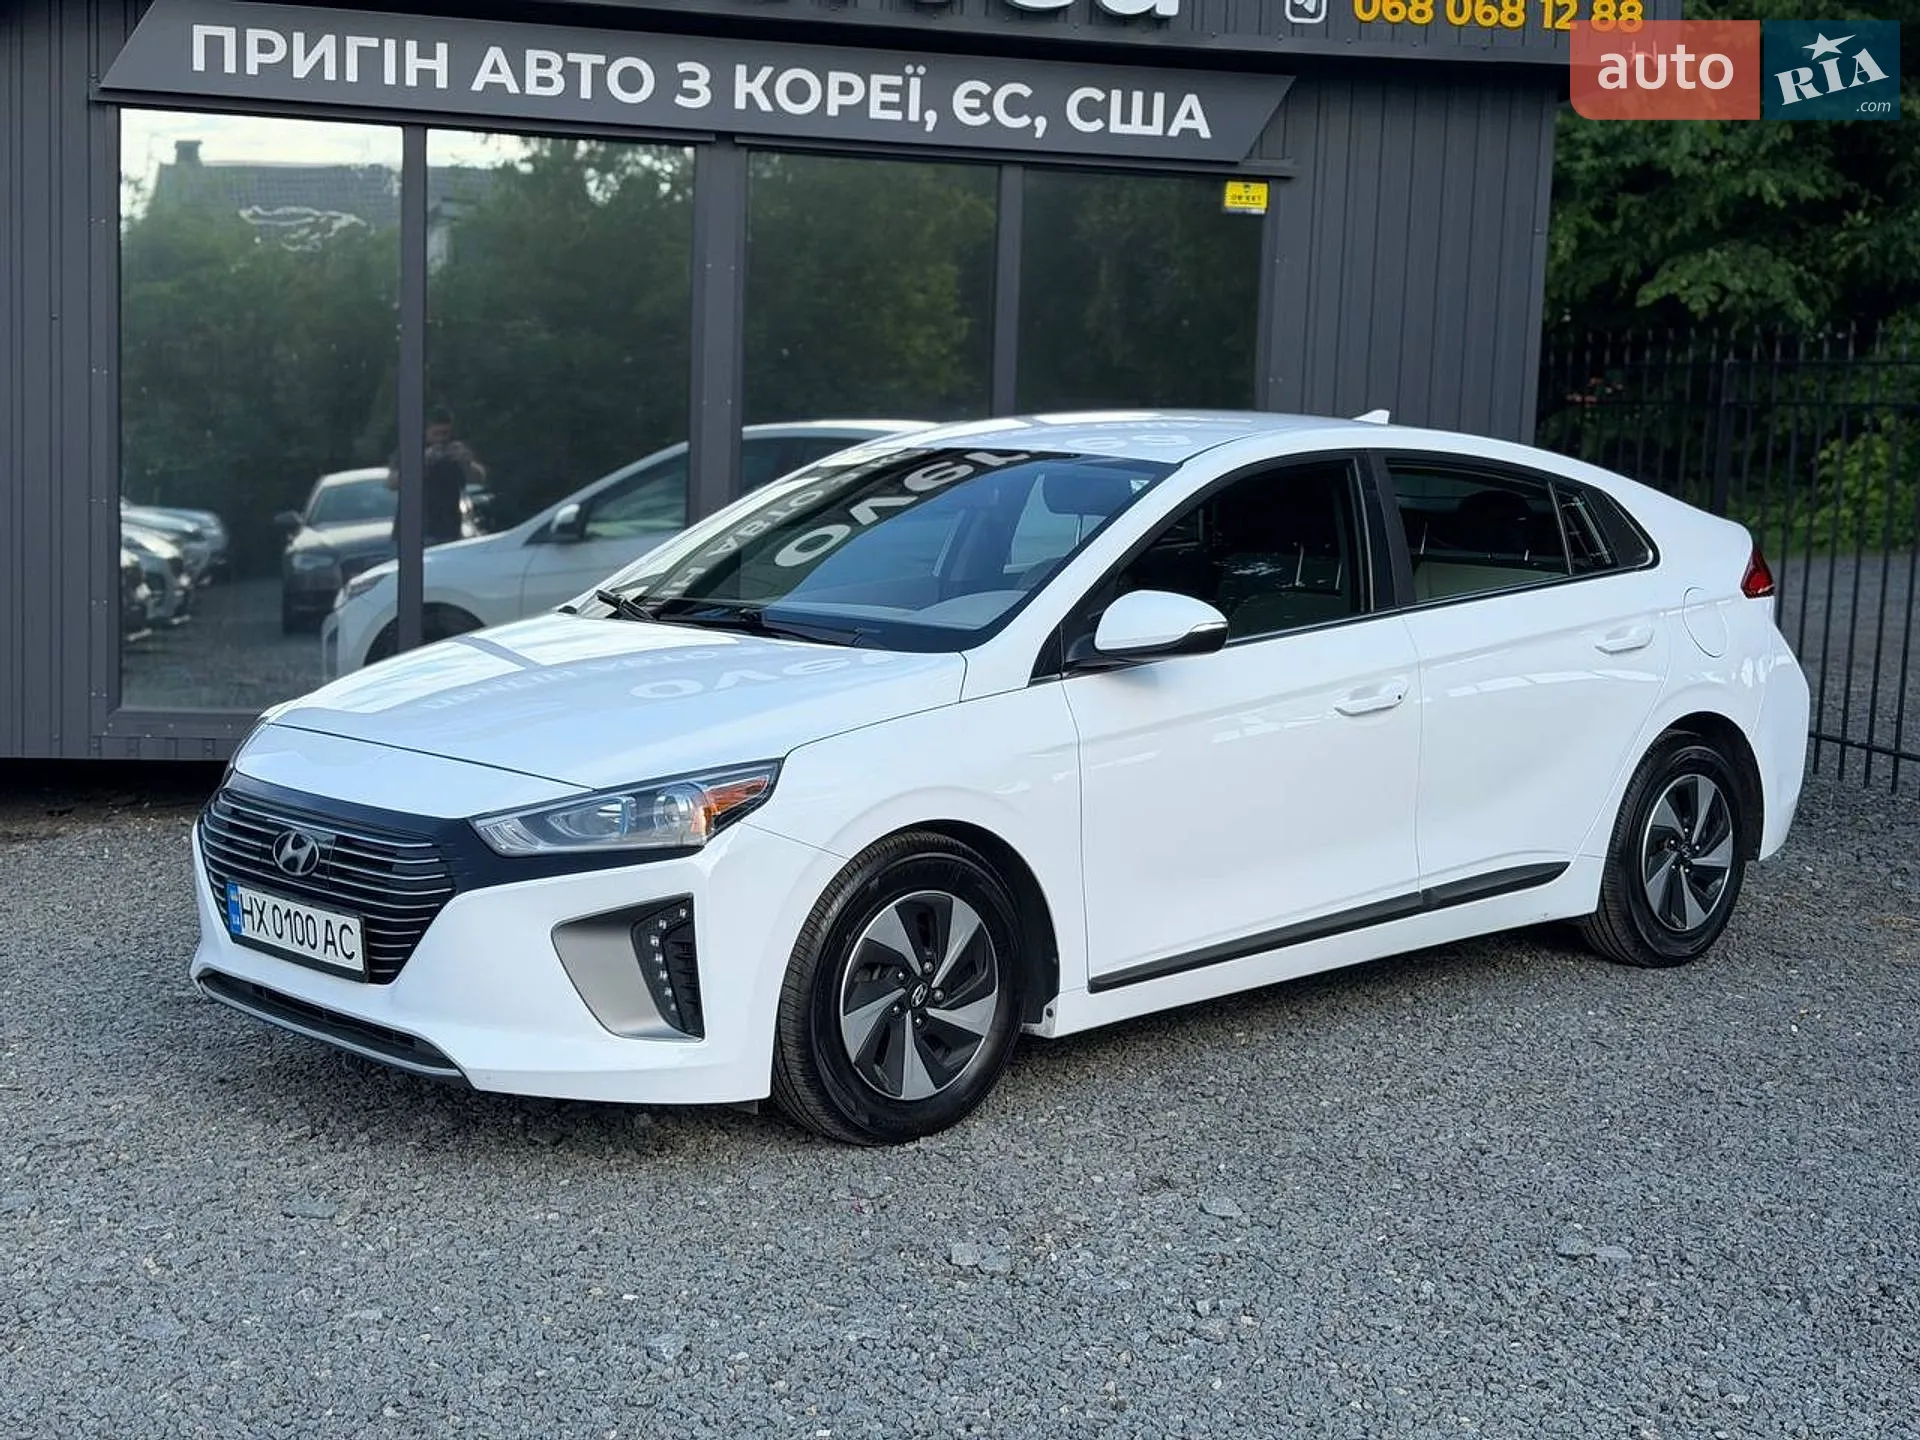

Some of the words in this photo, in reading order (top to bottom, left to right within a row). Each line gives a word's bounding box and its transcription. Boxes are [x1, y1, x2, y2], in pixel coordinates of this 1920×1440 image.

[1354, 0, 1433, 24] 068
[1446, 0, 1525, 27] 068
[1542, 0, 1577, 30] 12
[1591, 0, 1643, 32] 88
[192, 24, 448, 89] ПРИГІН
[469, 46, 656, 104] АВТО
[674, 61, 712, 109] З
[734, 64, 937, 133] КОРЕЇ,
[952, 80, 1047, 139] ЄС,
[1066, 86, 1212, 139] США
[239, 893, 270, 936] HX
[272, 903, 318, 950] 0100
[324, 919, 355, 960] AC
